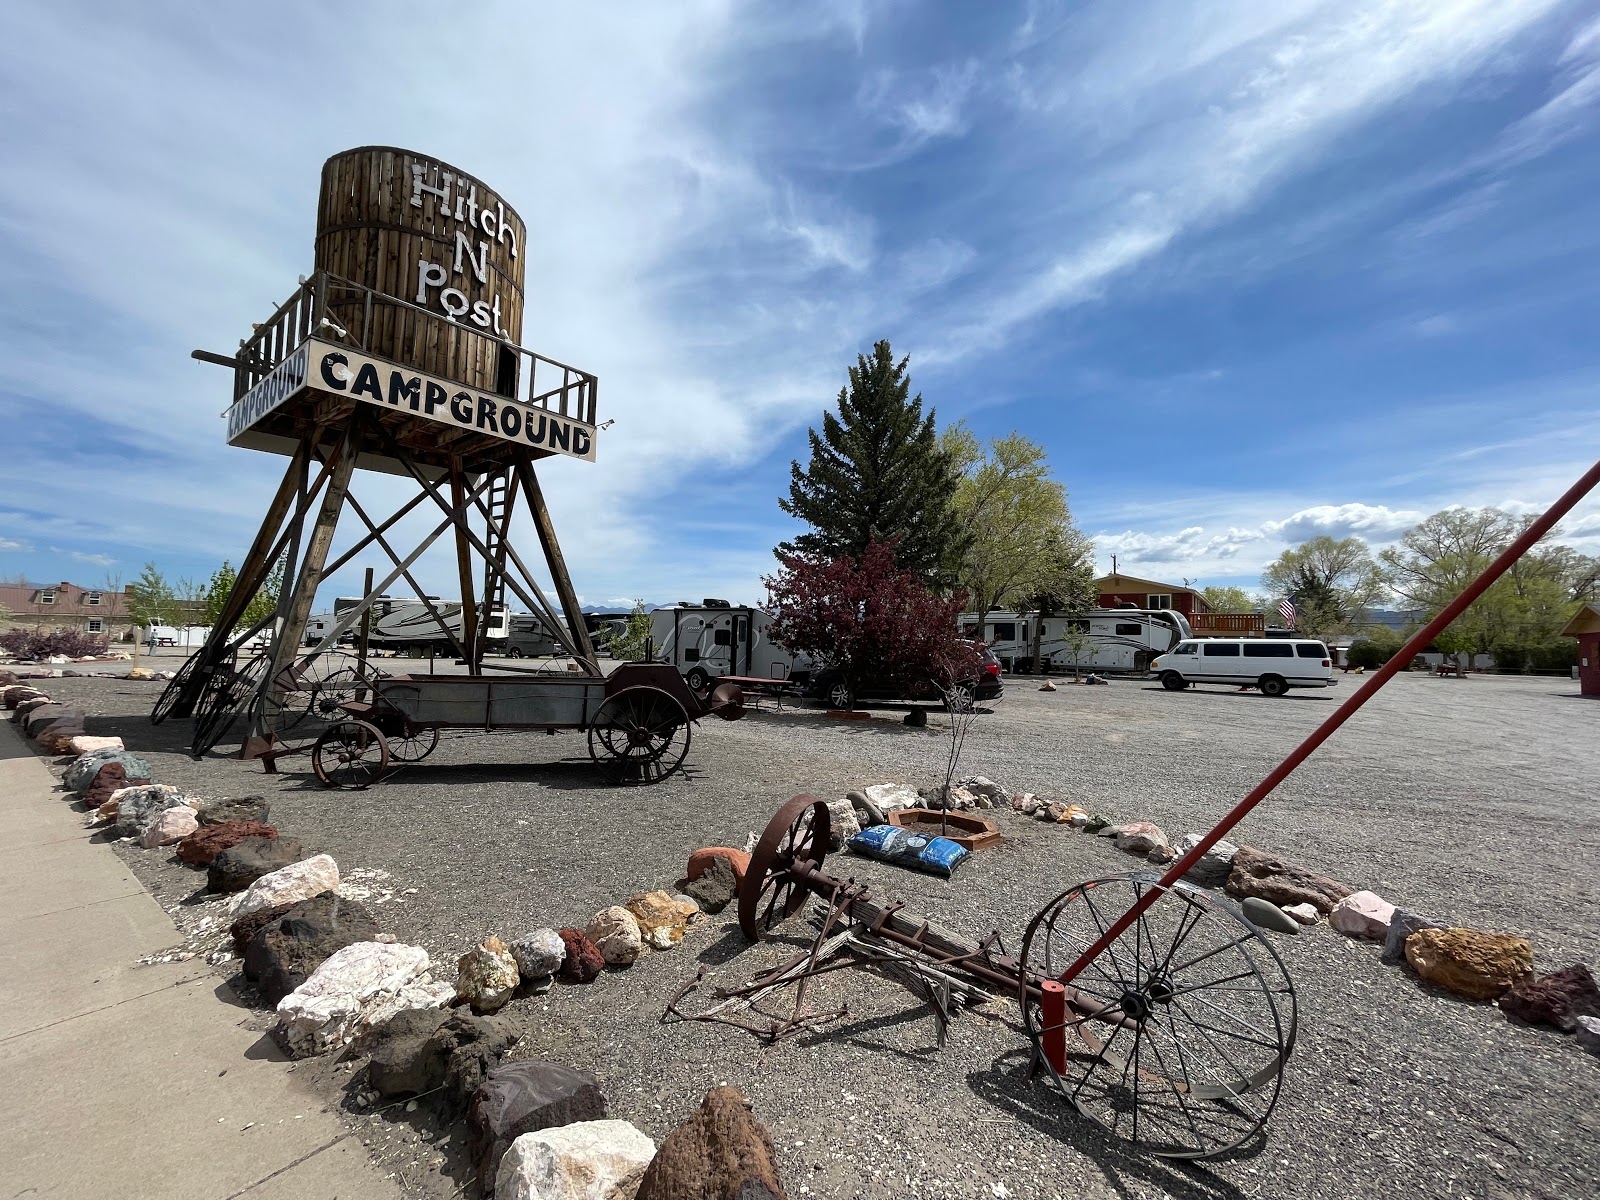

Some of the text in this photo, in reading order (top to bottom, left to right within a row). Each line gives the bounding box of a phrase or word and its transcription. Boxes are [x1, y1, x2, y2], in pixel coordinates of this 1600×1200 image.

[410, 164, 517, 258] Hitch
[453, 230, 488, 284] N
[229, 349, 306, 438] CAMPGROUND
[320, 352, 591, 455] CAMPGROUND
